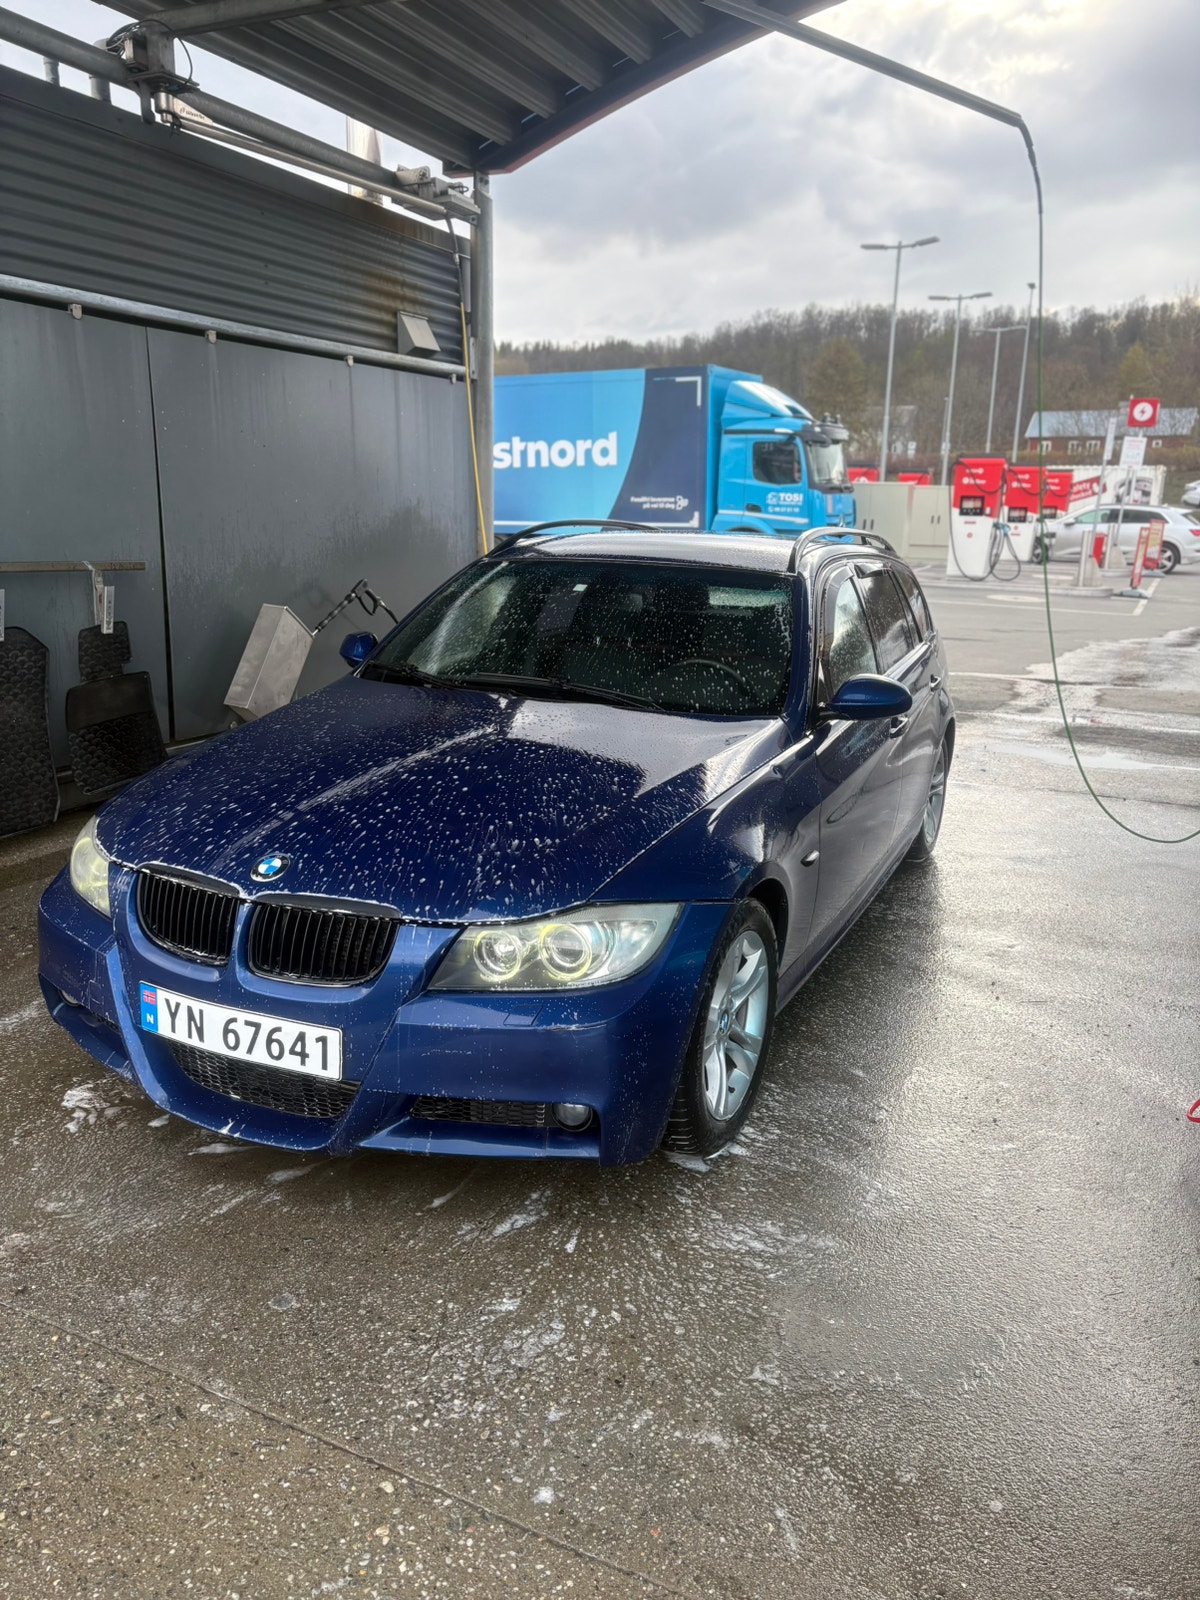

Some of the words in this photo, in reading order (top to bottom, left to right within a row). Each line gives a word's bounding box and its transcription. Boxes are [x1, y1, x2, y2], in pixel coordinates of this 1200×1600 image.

[779, 492, 804, 502] TOSI
[146, 1013, 155, 1025] N
[164, 998, 205, 1044] YN
[222, 1017, 329, 1072] 67641
